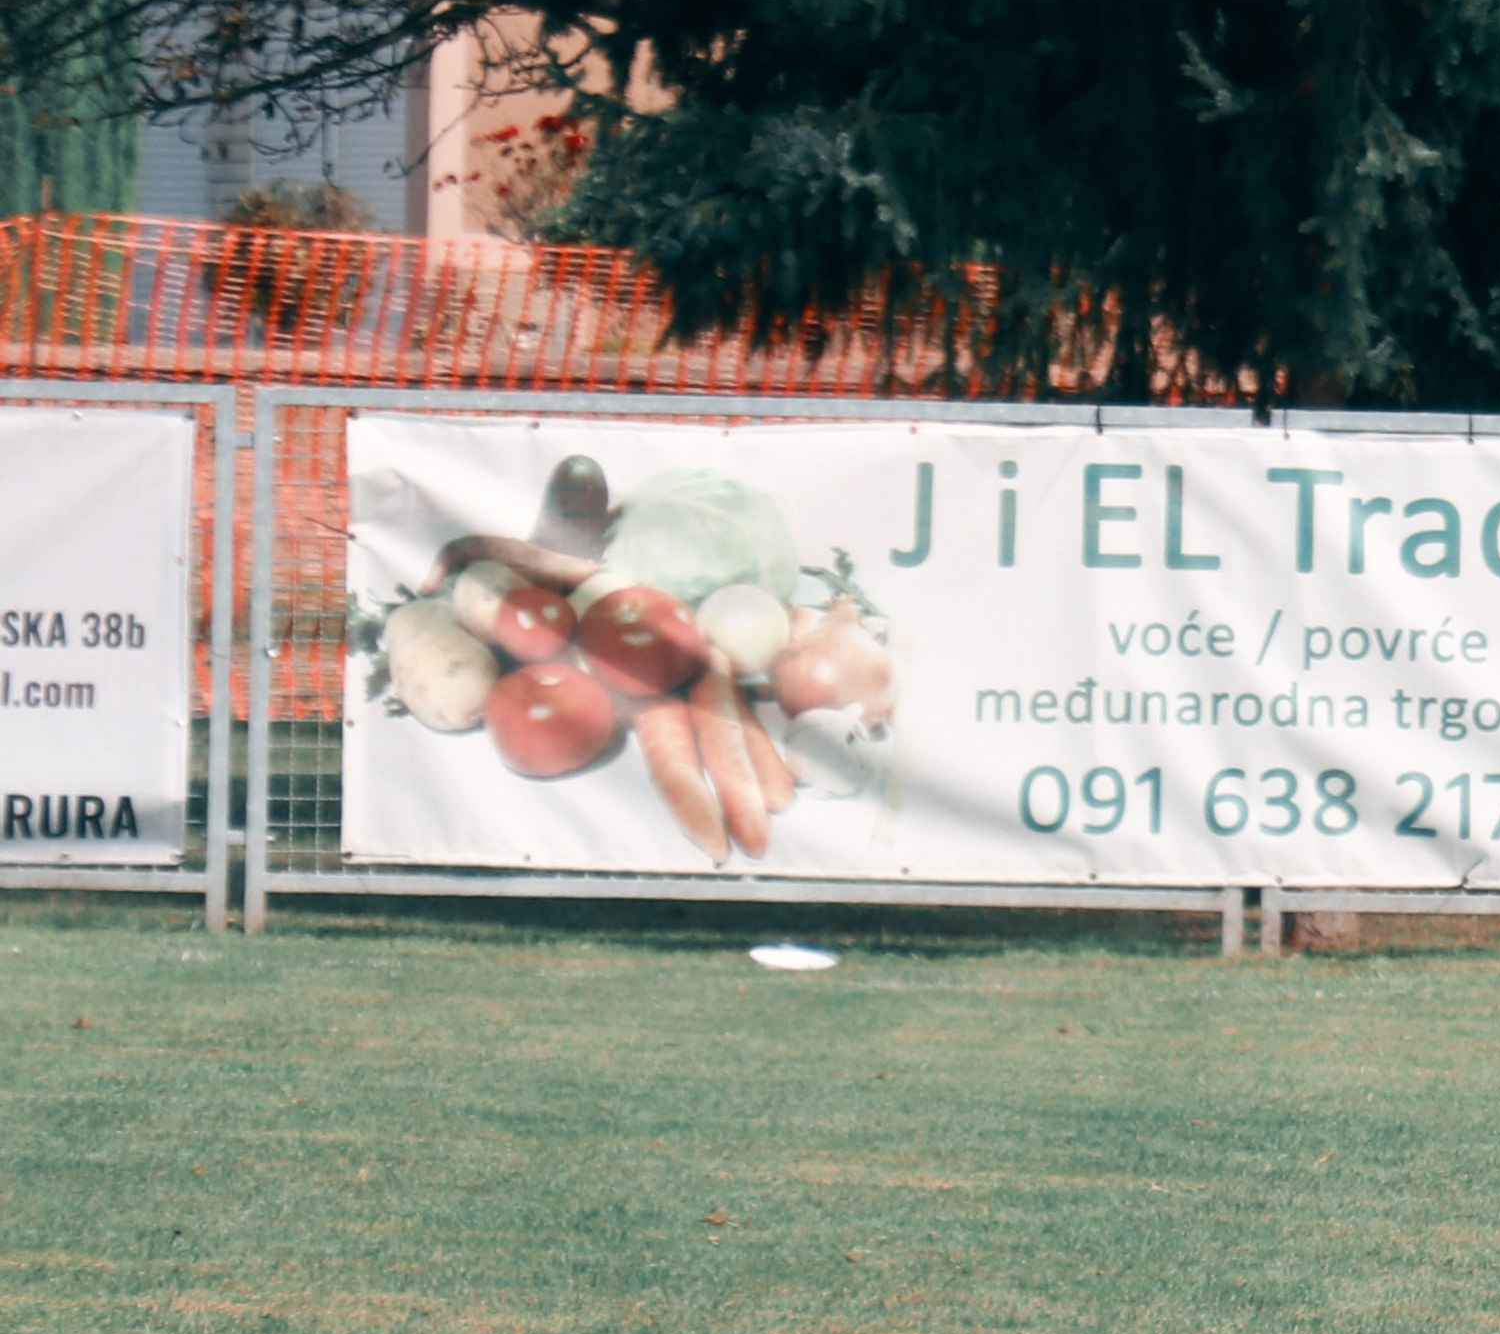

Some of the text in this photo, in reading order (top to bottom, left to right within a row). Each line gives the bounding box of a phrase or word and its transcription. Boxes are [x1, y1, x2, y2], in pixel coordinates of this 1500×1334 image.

[890, 462, 934, 568] J
[998, 460, 1017, 567] i
[1082, 463, 1221, 570] EL
[82, 612, 145, 649] 38b
[1108, 610, 1489, 670] voće / povrće
[976, 676, 1369, 730] međunarodna
[1018, 765, 1163, 836] 091
[1203, 768, 1360, 839] 638
